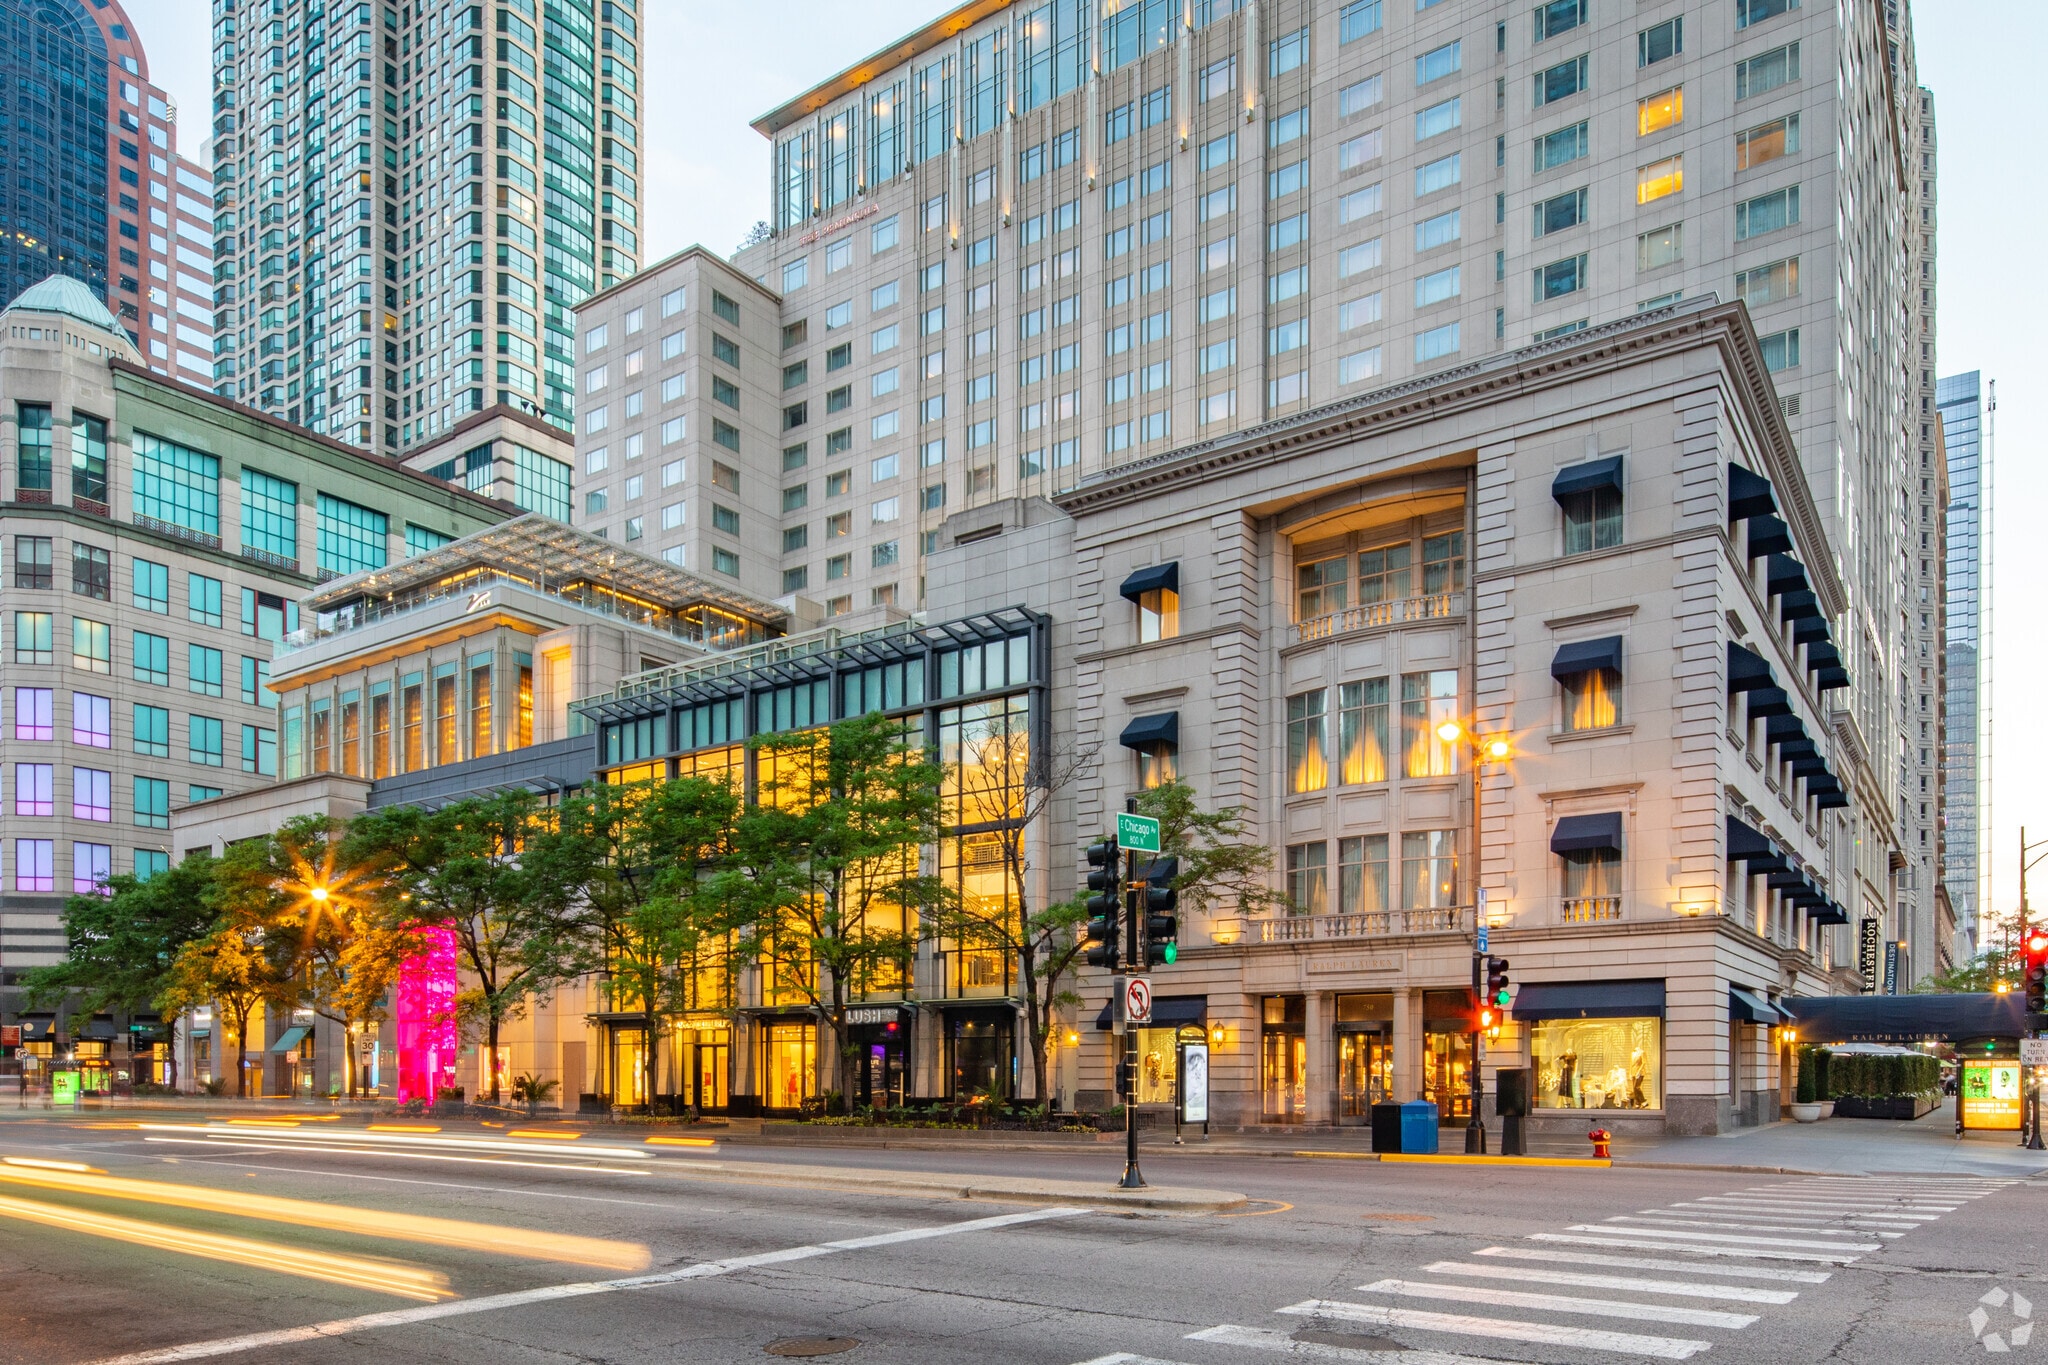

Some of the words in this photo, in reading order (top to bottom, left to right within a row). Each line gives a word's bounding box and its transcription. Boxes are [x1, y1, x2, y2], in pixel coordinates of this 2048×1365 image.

[823, 203, 880, 236] PENINSULA
[1120, 820, 1124, 828] E
[1124, 819, 1150, 838] Chicago
[1150, 826, 1156, 834] Av
[1130, 836, 1140, 845] 800
[1865, 922, 1876, 989] ROCHESTER
[1313, 960, 1346, 972] RALPH
[1351, 959, 1393, 970] LAUREN
[1887, 944, 1896, 990] DESTINATION
[845, 1008, 881, 1024] LUSH
[1852, 1033, 1891, 1041] RALPH
